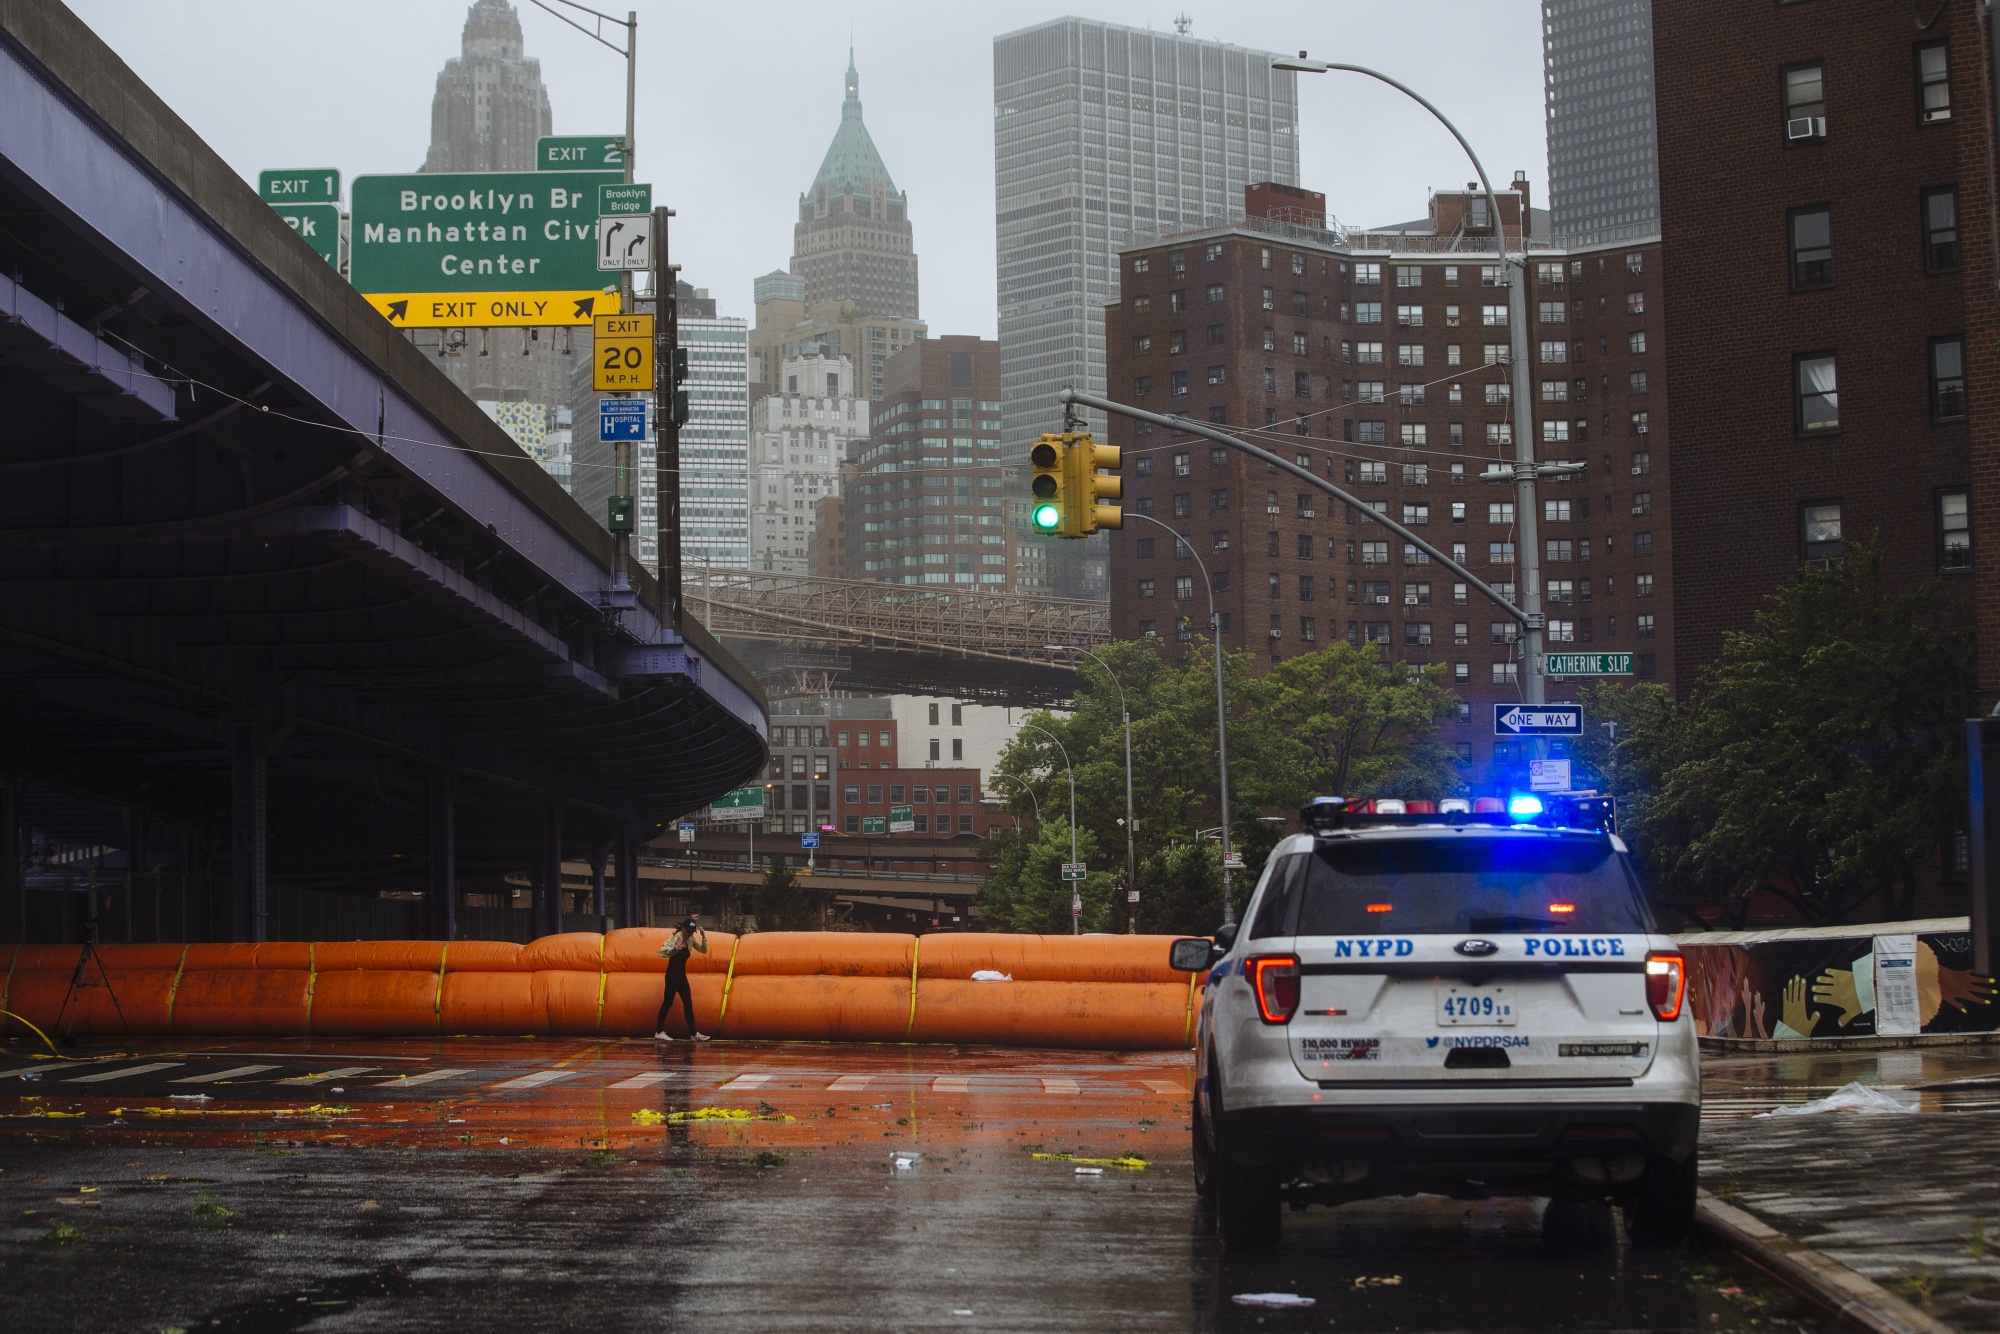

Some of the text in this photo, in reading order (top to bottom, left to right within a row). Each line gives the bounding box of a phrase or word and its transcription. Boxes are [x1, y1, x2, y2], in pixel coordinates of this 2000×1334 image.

[549, 143, 623, 163] EXIT 2
[271, 176, 333, 196] EXIT 1
[606, 189, 646, 200] Brooklyn
[400, 188, 583, 215] Brooklyn Br
[611, 201, 641, 212] Bridge
[364, 219, 600, 243] Manhattan Civi
[440, 254, 541, 276] Center
[603, 258, 645, 267] ONLY ONLY
[432, 301, 548, 317] EXIT ONLY
[608, 320, 640, 333] EXIT
[604, 346, 642, 369] 20
[606, 374, 641, 384] M.P.H.
[604, 416, 642, 434] HOSPITAL
[1549, 655, 1630, 673] CATHERINE SLIP
[1509, 714, 1571, 725] ONE WAY
[1334, 939, 1414, 957] NYPD
[1523, 938, 1625, 956] POLICE
[1444, 996, 1493, 1016] 4709
[1302, 1039, 1338, 1050] $10,000
[1340, 1039, 1380, 1049] REWARD
[1443, 1035, 1530, 1049] @NYPDPSA4
[1597, 1045, 1633, 1053] INSPIRES
